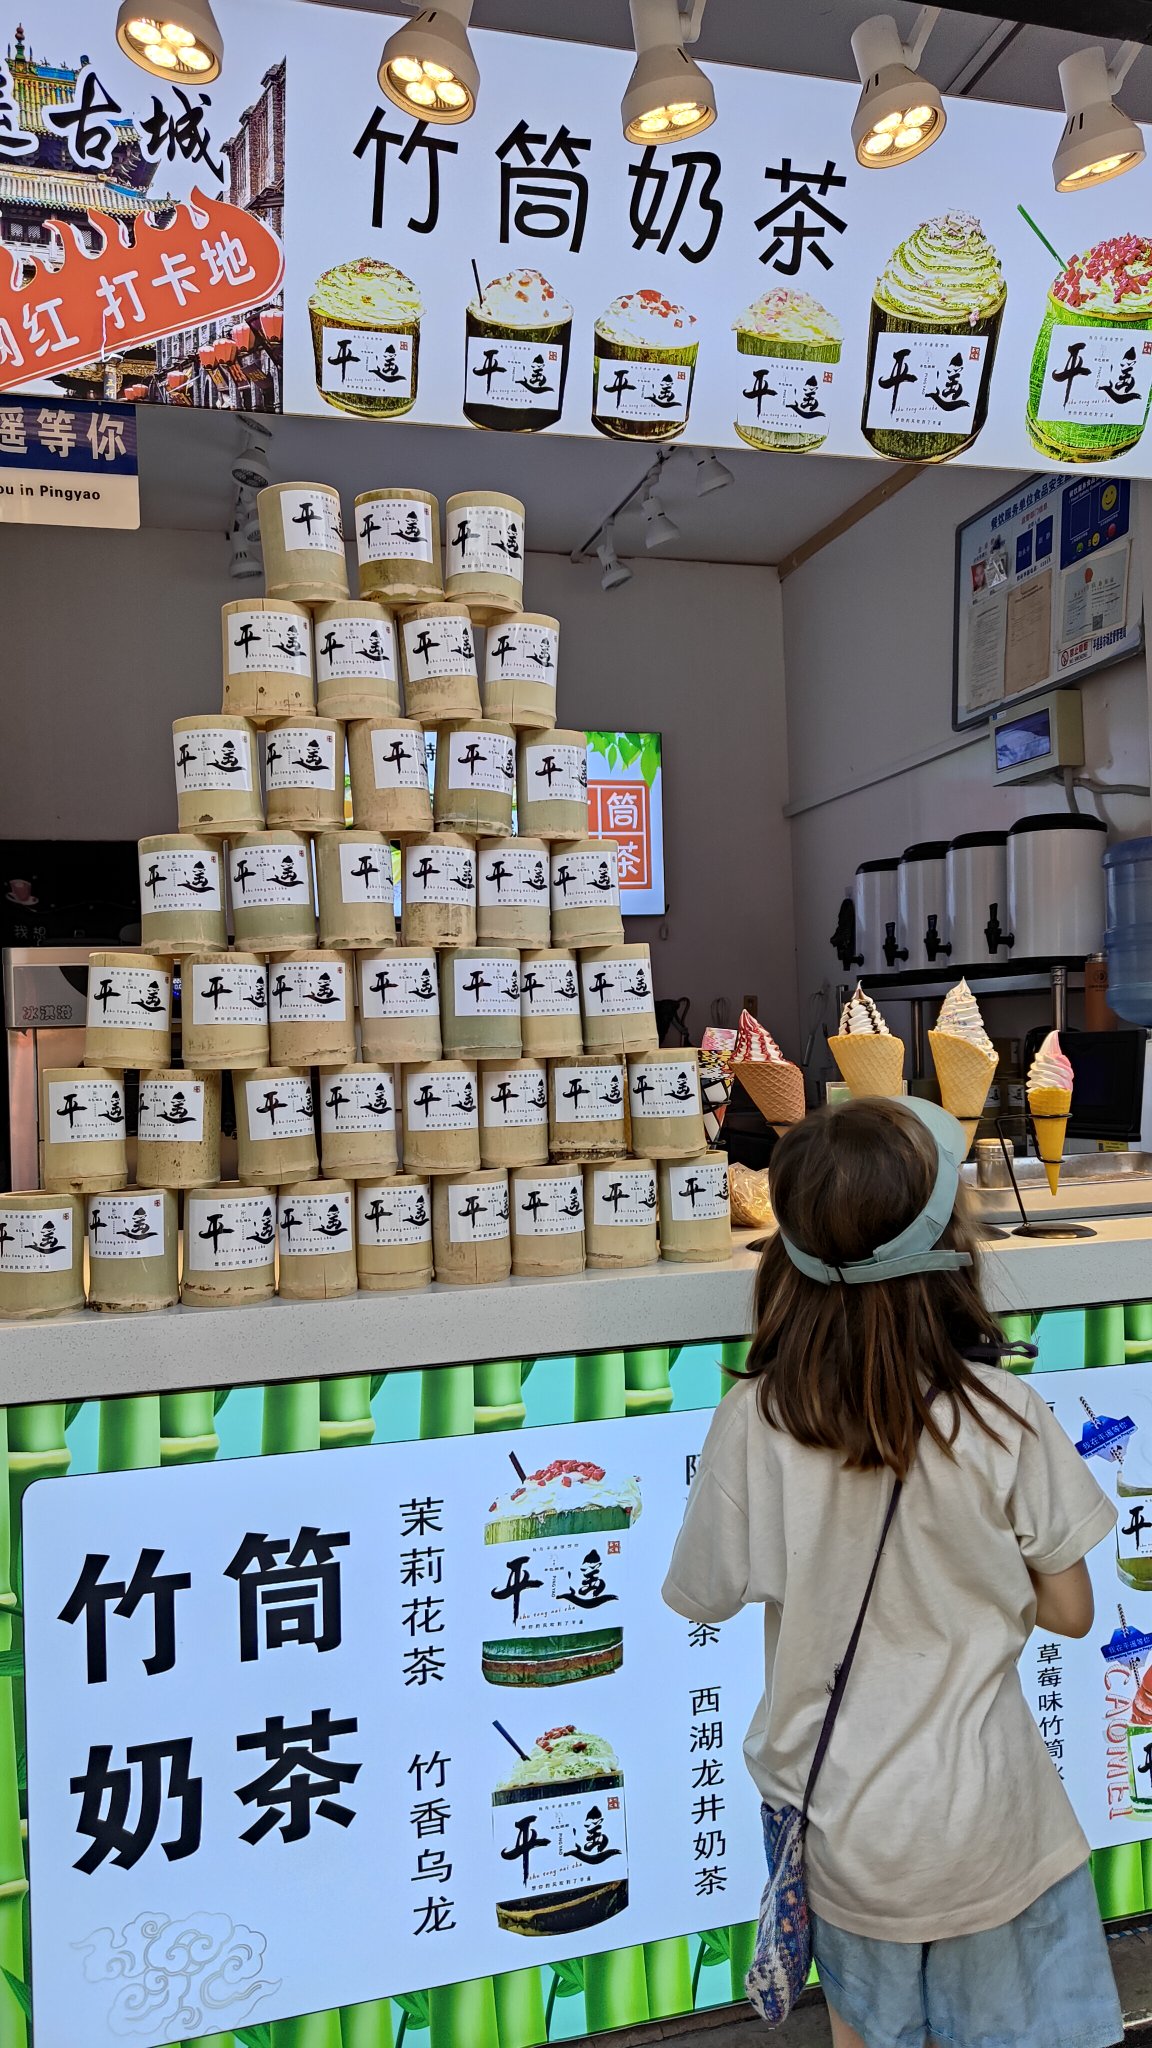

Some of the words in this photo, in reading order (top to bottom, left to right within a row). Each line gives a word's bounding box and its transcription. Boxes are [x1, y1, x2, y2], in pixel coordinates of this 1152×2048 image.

[352, 105, 848, 275] 竹筒奶茶
[328, 340, 406, 384] 平遥
[473, 349, 555, 395] 平遥
[1052, 342, 1142, 411] 平遥
[603, 370, 682, 410] 平遥
[743, 369, 826, 420] 平遥
[878, 349, 970, 418] 平遥
[0, 406, 126, 461] 遥等你
[20, 484, 34, 496] in
[40, 485, 101, 501] Pingyao
[360, 511, 427, 548] 平遥
[452, 520, 522, 559] 平遥
[234, 623, 306, 658] 平遥
[320, 630, 390, 667] 平遥
[413, 627, 474, 664] 平遥
[492, 635, 554, 667] 平遥
[177, 740, 246, 779] 平遥
[266, 739, 329, 777] 平遥
[606, 792, 638, 829] 筒
[145, 860, 215, 899] 平遥
[234, 855, 304, 894] 平遥
[413, 858, 475, 890] 平遥
[486, 860, 547, 892] 平遥
[553, 860, 615, 896] 平遥
[94, 979, 166, 1014] 平遥
[201, 976, 267, 1010] 平遥
[272, 972, 341, 1008] 平遥
[370, 968, 436, 1004] 平遥
[521, 969, 577, 1004] 平遥
[589, 968, 651, 1003] 平遥
[326, 1083, 392, 1119] 平遥
[414, 1082, 476, 1117] 平遥
[563, 1075, 622, 1109] 平遥
[633, 1072, 695, 1106] 平遥
[57, 1090, 124, 1128] 平遥
[281, 1204, 348, 1242] 平遥
[365, 1195, 429, 1232] 平遥
[522, 1186, 582, 1222] 平遥
[90, 1207, 158, 1245] 平遥
[199, 1207, 275, 1254] 平遥
[57, 1526, 351, 1685] 竹筒
[399, 1496, 446, 1687] 茉莉花茶
[491, 1548, 619, 1627] 平遥
[69, 1708, 363, 1876] 奶茶
[689, 1686, 728, 1896] 西湖龙井奶茶
[407, 1750, 456, 1937] 竹香乌龙
[500, 1805, 622, 1888] 平遥
